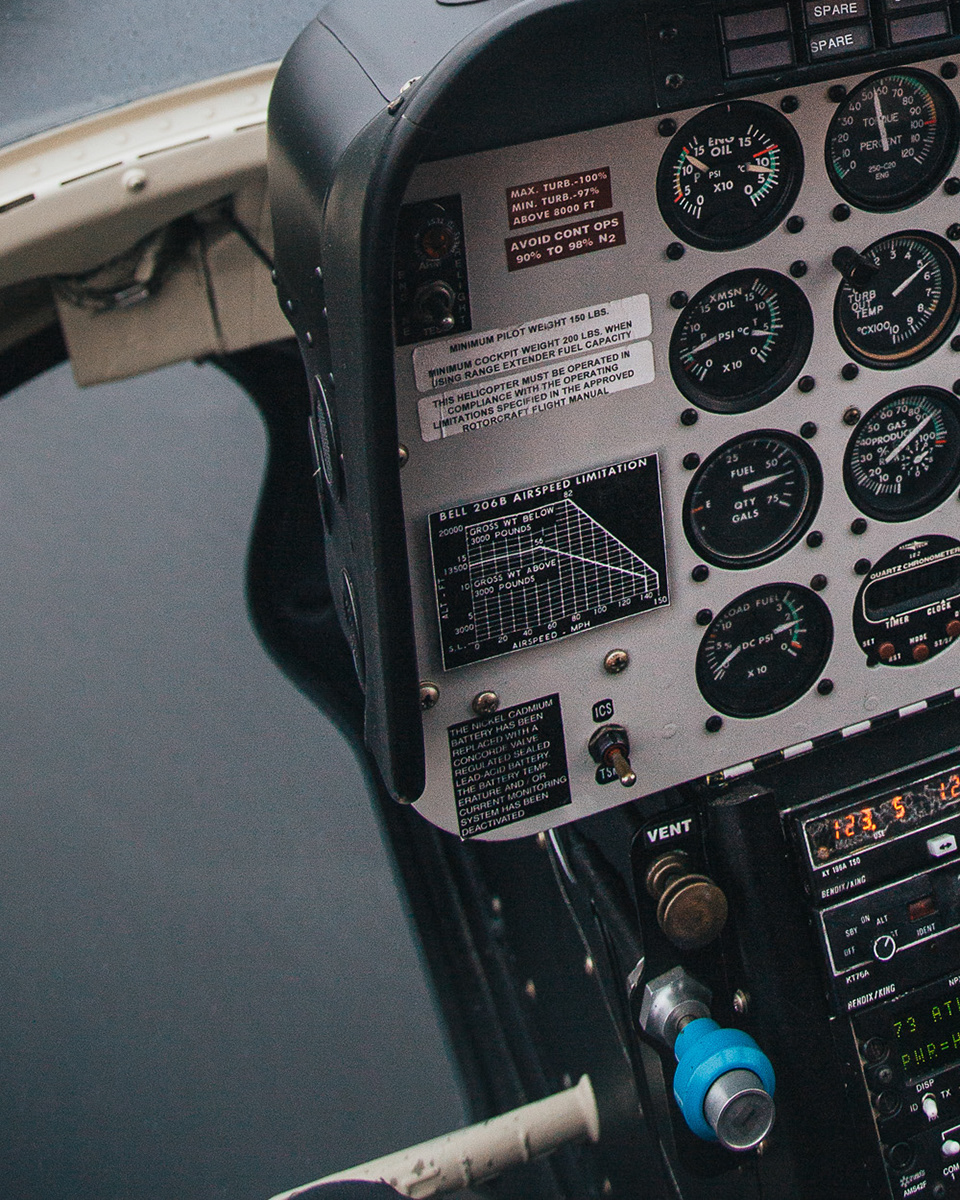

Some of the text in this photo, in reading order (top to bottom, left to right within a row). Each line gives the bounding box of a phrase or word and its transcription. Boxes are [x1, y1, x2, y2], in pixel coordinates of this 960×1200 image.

[813, 2, 858, 18] SPARE
[810, 33, 854, 53] SPARE
[863, 112, 899, 128] TOUE
[711, 145, 733, 157] OIL
[511, 186, 539, 199] MAX.
[512, 200, 538, 213] MIN.
[513, 200, 596, 226] ABOVE 8000 FT
[510, 218, 620, 252] AVOID CONT OPS
[516, 250, 542, 264] 90%
[546, 244, 563, 256] TO
[568, 237, 594, 251] 98%
[709, 287, 742, 303] XMSN
[848, 289, 876, 303] TURB
[449, 307, 610, 354] MINIMUM PILOT WEIGHT 150 LBS.
[428, 320, 633, 378] MINIMUM COCKPIT WEIGHT 200 LBS. WHEN
[431, 330, 632, 388] USING RANGE EXTENDER FUEL CAPACITY
[432, 350, 631, 408] THIS HELICOPTER MUST BE OPERATED IN
[447, 363, 619, 415] COMPLIANCE WITH THE OPERATING
[433, 369, 635, 430] LIMITATIONS SPECIFIED IN THE APPROVED
[462, 386, 610, 433] ROTORCRAFT FLIGHT MANUAL
[730, 465, 755, 479] FUEL
[439, 457, 647, 522] BELL 206B AIRSPEED LIMITATION
[733, 496, 757, 510] QTY
[469, 506, 555, 536] GROSS WT BELOW
[731, 508, 759, 524] GALS
[470, 524, 532, 546] 3000 POUNDS
[473, 558, 557, 588] GROSS WT ABOVE
[870, 565, 903, 580] QUARTZ
[902, 546, 960, 570] CHRONOMETER
[474, 575, 536, 598] 3000 POUNDS
[512, 620, 591, 650] AIRSPEED MPH
[885, 615, 910, 629] TIMER
[742, 638, 756, 650] DC
[449, 699, 554, 738] THE NICKEL CADMIUM
[595, 702, 613, 718] ICS
[451, 712, 544, 748] BATTERY HAS BEEN
[452, 724, 539, 757] REPLACED WITH A
[453, 734, 539, 767] CONCORDE VALVE
[454, 740, 551, 777] REGULATED SEALED
[455, 765, 506, 788] LEAD-ACID
[456, 785, 477, 798] THE
[478, 770, 520, 791] BATTERY
[458, 772, 547, 808] ERATURE AND OR
[459, 775, 568, 817] CURRENT MONITORING
[460, 791, 550, 828] SYSTEM HAS BEEN
[461, 809, 526, 837] DEACTIVATED
[646, 818, 693, 843] VENT
[916, 922, 937, 937] IDENT
[847, 983, 896, 1010] BENDIX/KING
[915, 1078, 935, 1093] DISP
